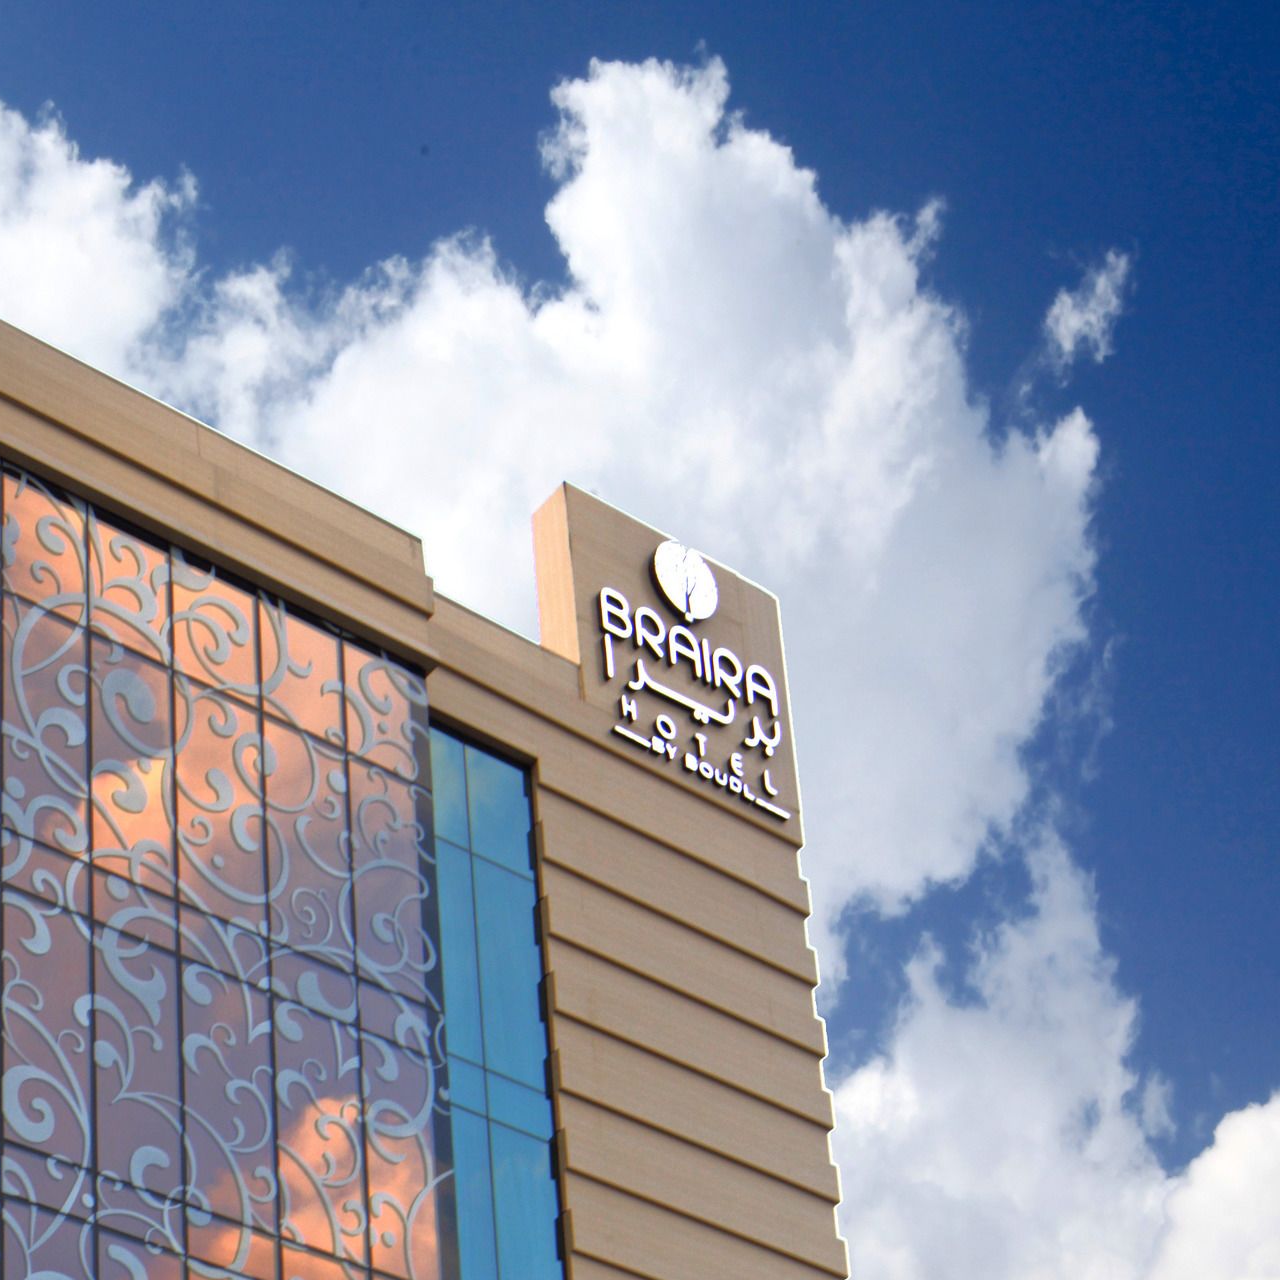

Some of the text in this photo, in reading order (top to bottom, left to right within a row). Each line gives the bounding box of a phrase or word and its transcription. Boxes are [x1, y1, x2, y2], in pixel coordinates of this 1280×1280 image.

[599, 586, 779, 717] BRAIRA
[603, 633, 782, 757] بريرا
[620, 694, 779, 796] HOTEL
[651, 735, 756, 802] BY BOUDL
